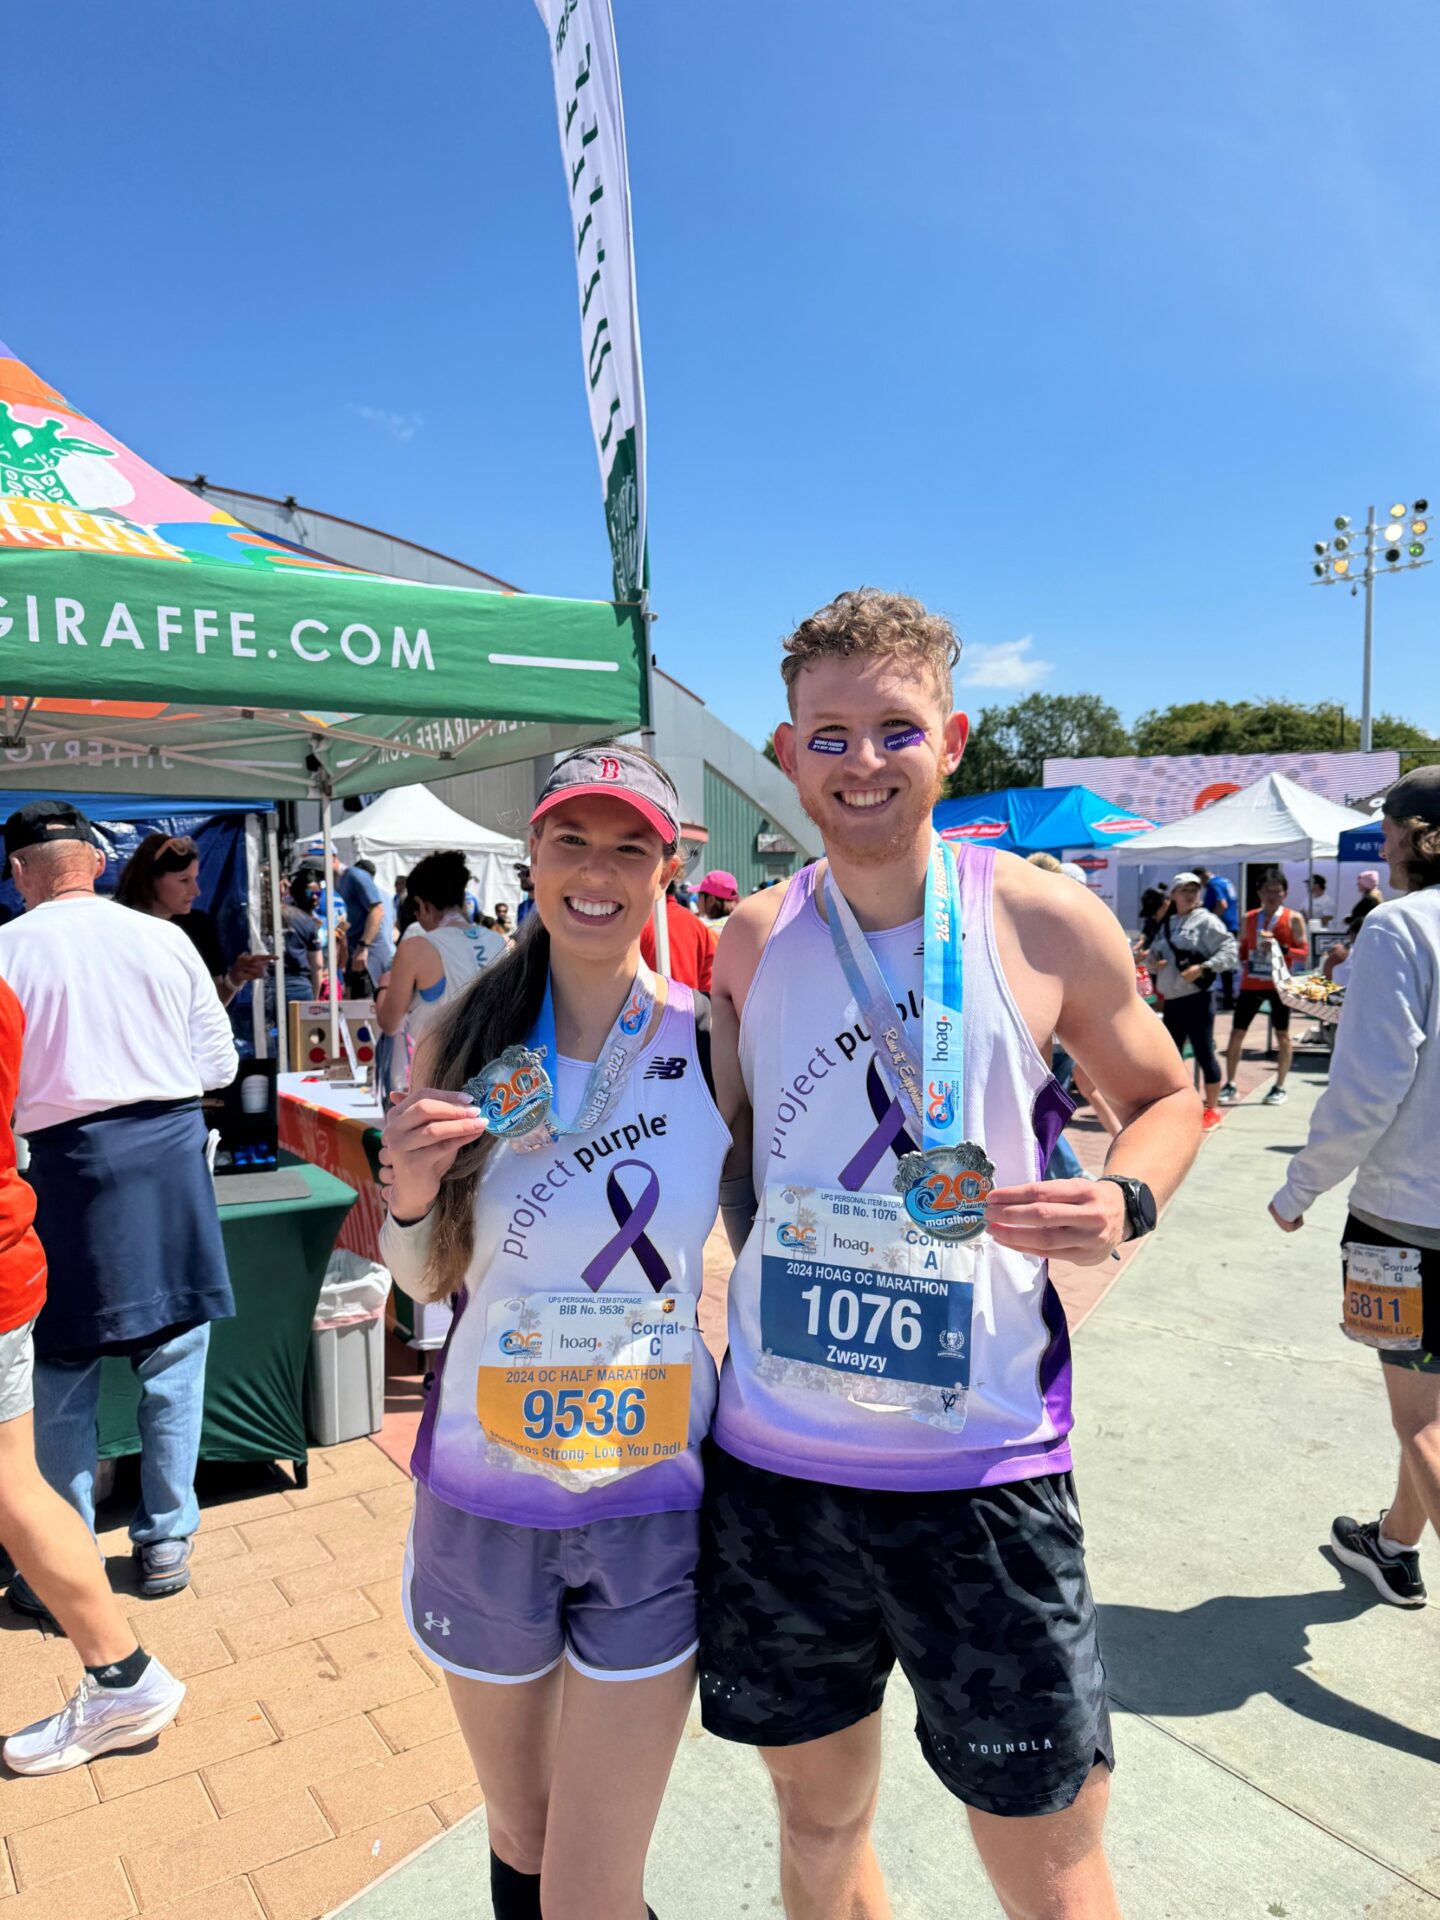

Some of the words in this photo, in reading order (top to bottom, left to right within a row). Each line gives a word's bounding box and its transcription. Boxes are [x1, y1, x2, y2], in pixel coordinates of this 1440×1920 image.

[596, 757, 621, 780] B
[604, 1046, 628, 1082] 2024
[770, 1046, 837, 1160] project
[834, 989, 924, 1062] pul
[502, 1159, 576, 1260] project
[573, 1113, 668, 1173] purple
[832, 1203, 850, 1216] BIB
[853, 1206, 870, 1218] No.
[872, 1208, 897, 1221] 1076
[883, 1200, 905, 1209] STORA
[924, 1250, 938, 1270] A
[786, 1262, 813, 1277] 2024
[815, 1266, 852, 1282] HOAG
[855, 1272, 873, 1286] OC
[876, 1274, 949, 1297] MARATHON
[559, 1305, 577, 1315] BIB
[580, 1305, 597, 1315] No.
[599, 1305, 625, 1315] 9536
[801, 1285, 923, 1351] 1076
[631, 1322, 679, 1335] Corral
[650, 1337, 661, 1356] C
[826, 1345, 888, 1374] Zwayzy
[506, 1371, 534, 1383] 2024
[538, 1369, 556, 1382] OC
[560, 1369, 593, 1382] HALF
[597, 1368, 667, 1381] MARATHON
[523, 1386, 646, 1440] 9536
[594, 1444, 623, 1459] Love
[627, 1443, 649, 1457] You
[653, 1441, 681, 1456] Dad!
[967, 1738, 1053, 1755] YOUNGLA
